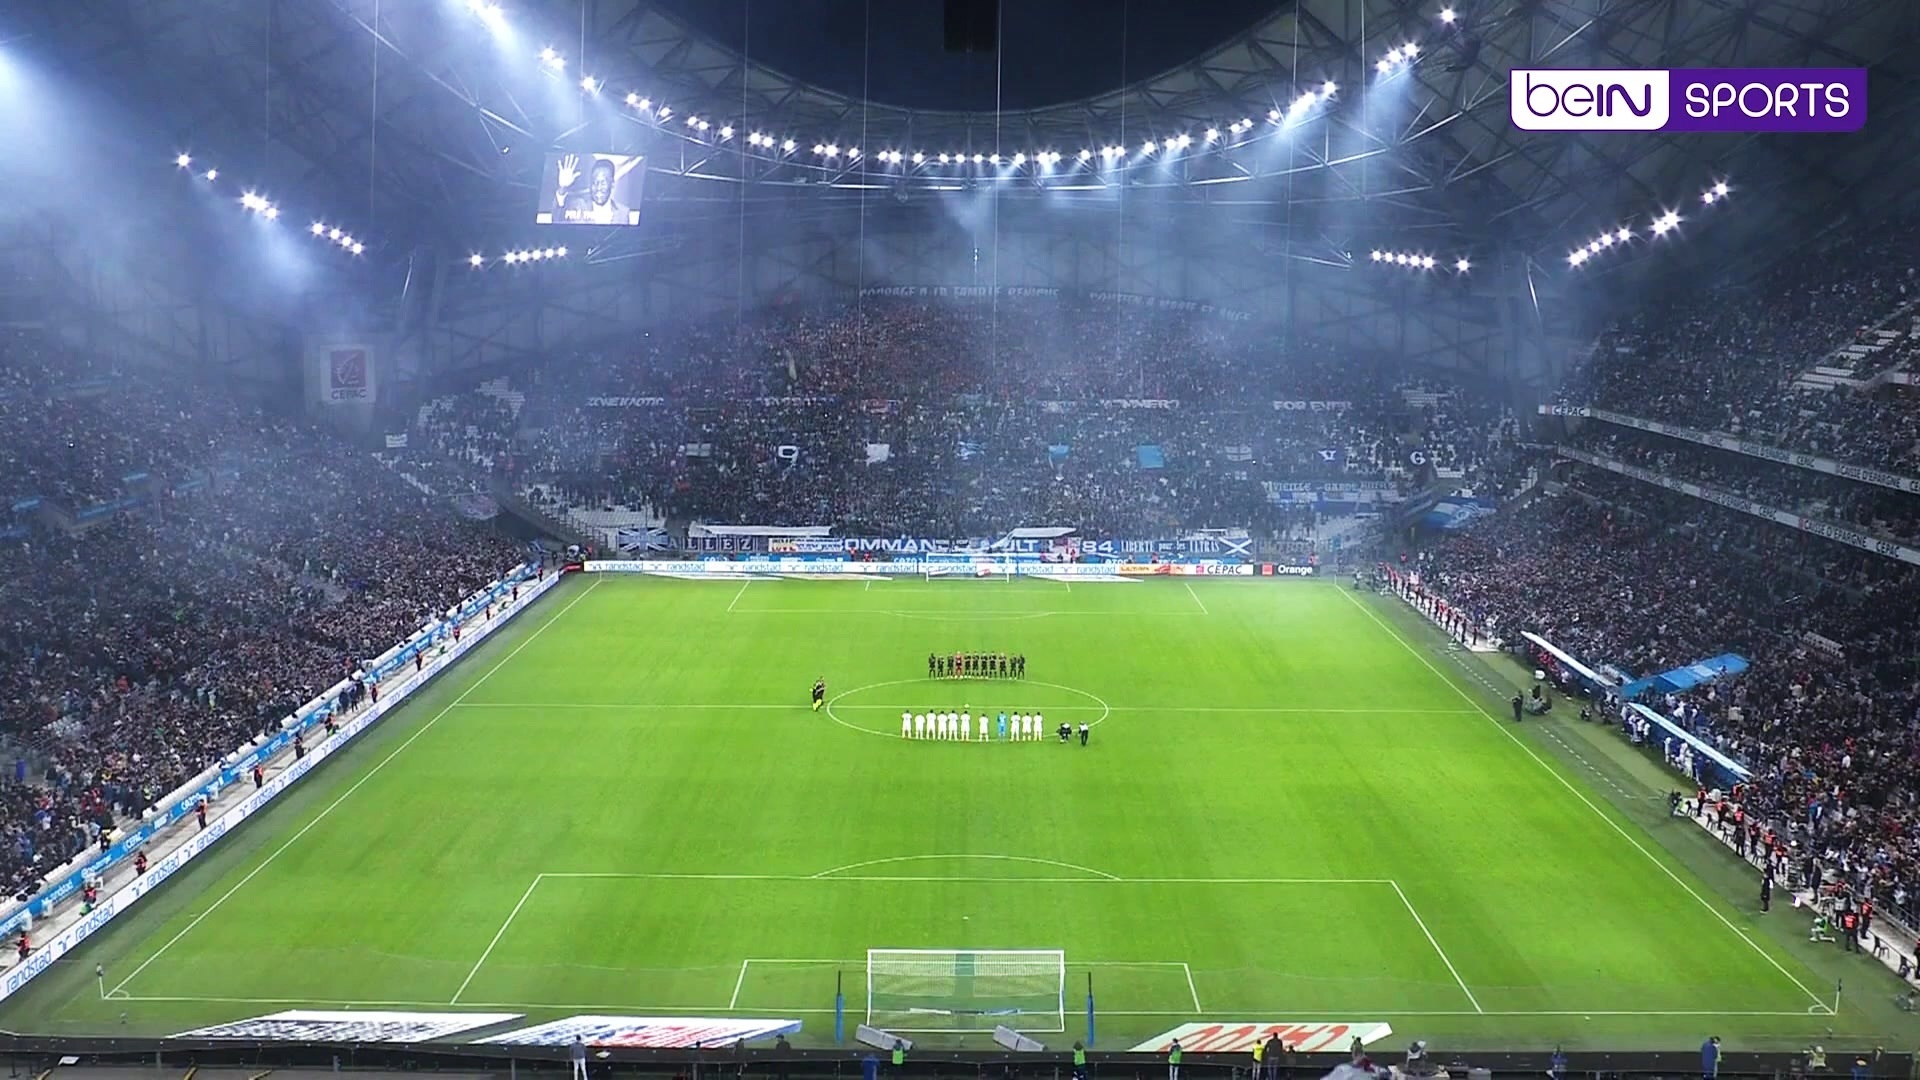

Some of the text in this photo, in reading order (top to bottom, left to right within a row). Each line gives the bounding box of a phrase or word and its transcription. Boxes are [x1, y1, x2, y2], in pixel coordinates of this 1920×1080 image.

[1553, 406, 1585, 417] CEPAC
[743, 564, 780, 572] randstad
[804, 563, 843, 571] randstad
[1207, 564, 1243, 574] CEPAC
[1278, 564, 1313, 576] Orange
[75, 897, 115, 942] randstad
[6, 950, 52, 994] randstad
